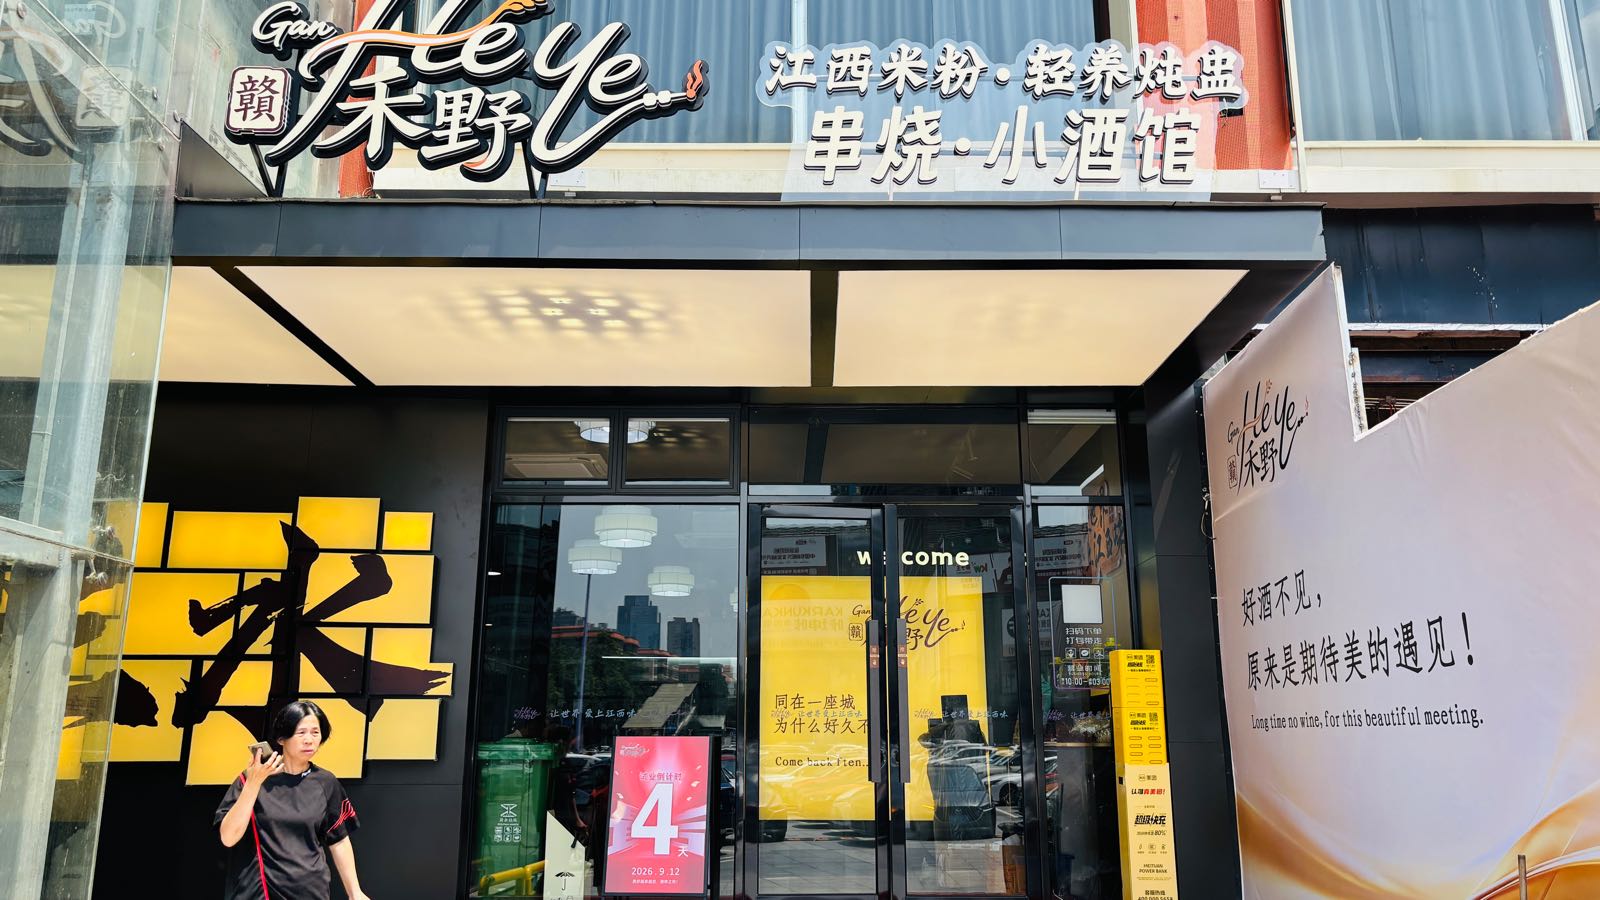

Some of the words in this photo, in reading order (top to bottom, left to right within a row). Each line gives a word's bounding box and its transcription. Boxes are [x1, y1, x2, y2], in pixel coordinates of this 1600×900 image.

[252, 1, 341, 52] Gan
[312, 65, 532, 178] 禾野
[1244, 437, 1278, 488] 禾野
[856, 550, 970, 567] wcome
[775, 693, 856, 710] 同在一座城
[1251, 714, 1269, 732] Long
[1270, 713, 1286, 729] time
[1288, 716, 1299, 728] no
[1300, 712, 1323, 729] wine,
[1325, 710, 1340, 728] for
[1343, 709, 1363, 727] this
[1364, 706, 1422, 727] beautiful
[1424, 703, 1484, 729] meeting.
[775, 756, 804, 766] Come
[631, 783, 679, 855] 4
[678, 846, 689, 857] 天
